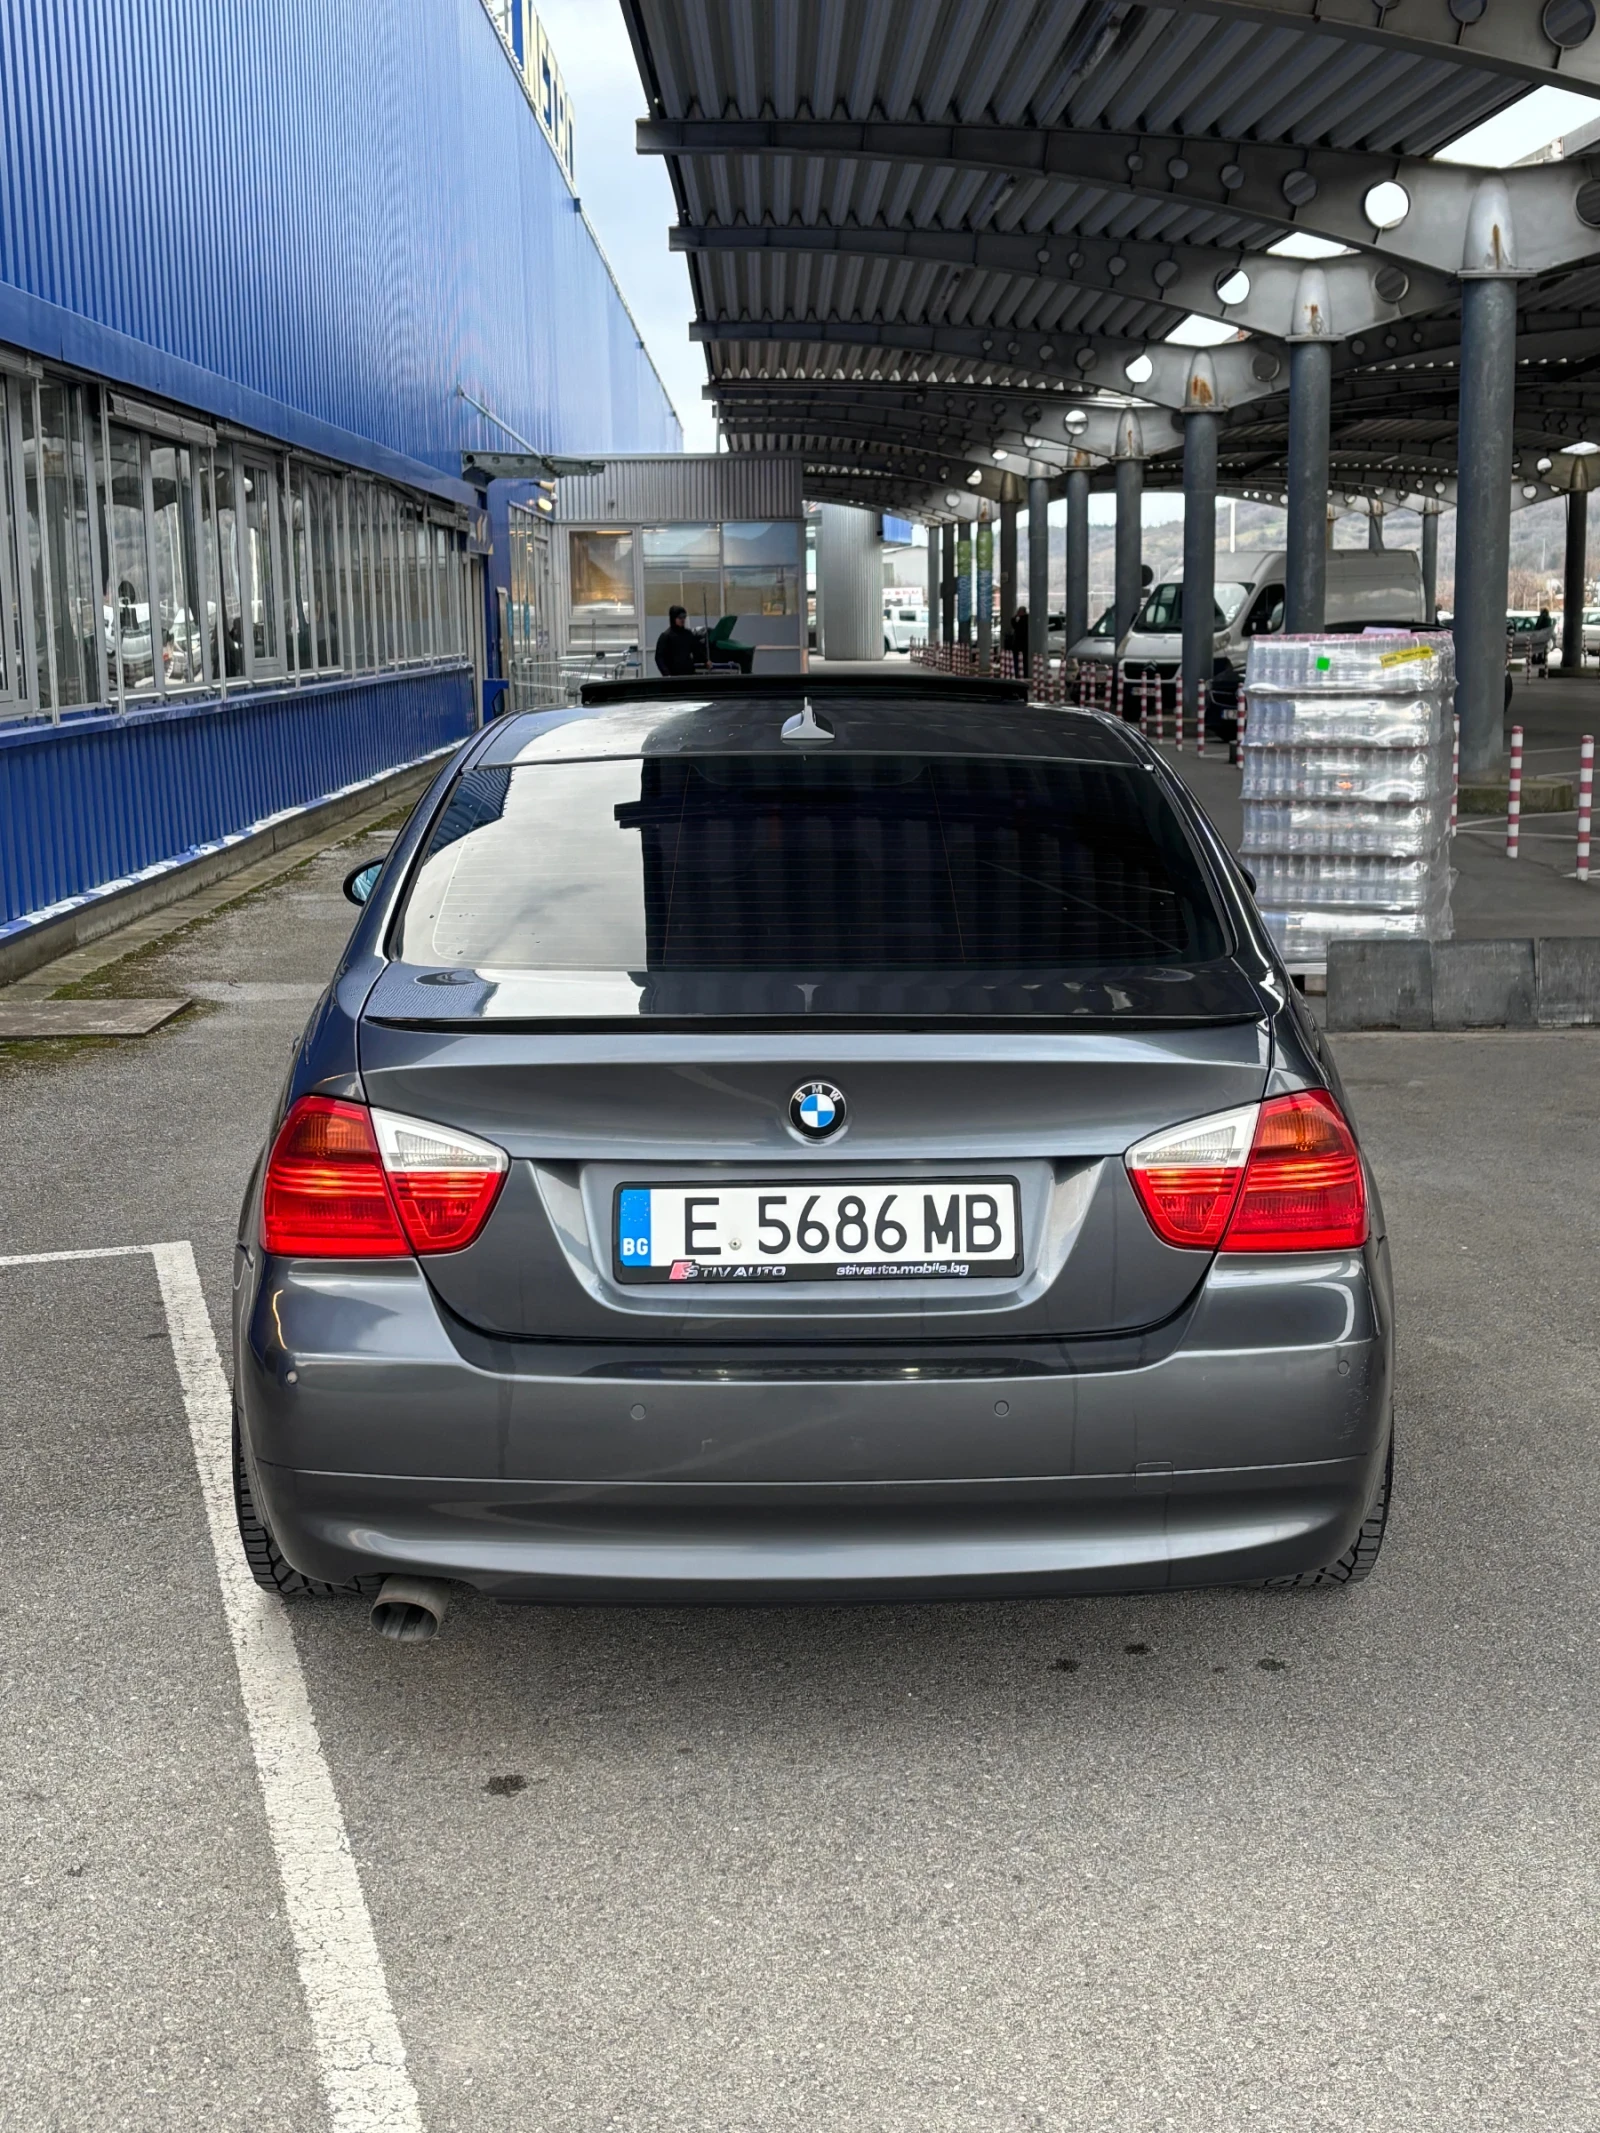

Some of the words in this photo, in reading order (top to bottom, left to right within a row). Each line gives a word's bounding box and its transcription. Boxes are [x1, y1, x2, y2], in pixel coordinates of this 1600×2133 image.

[794, 1084, 842, 1102] BMW
[684, 1197, 721, 1255] E
[758, 1195, 907, 1254] 5686
[923, 1194, 1002, 1254] MB
[622, 1237, 649, 1256] BG
[836, 1262, 969, 1276] stivauto.mobile.bg
